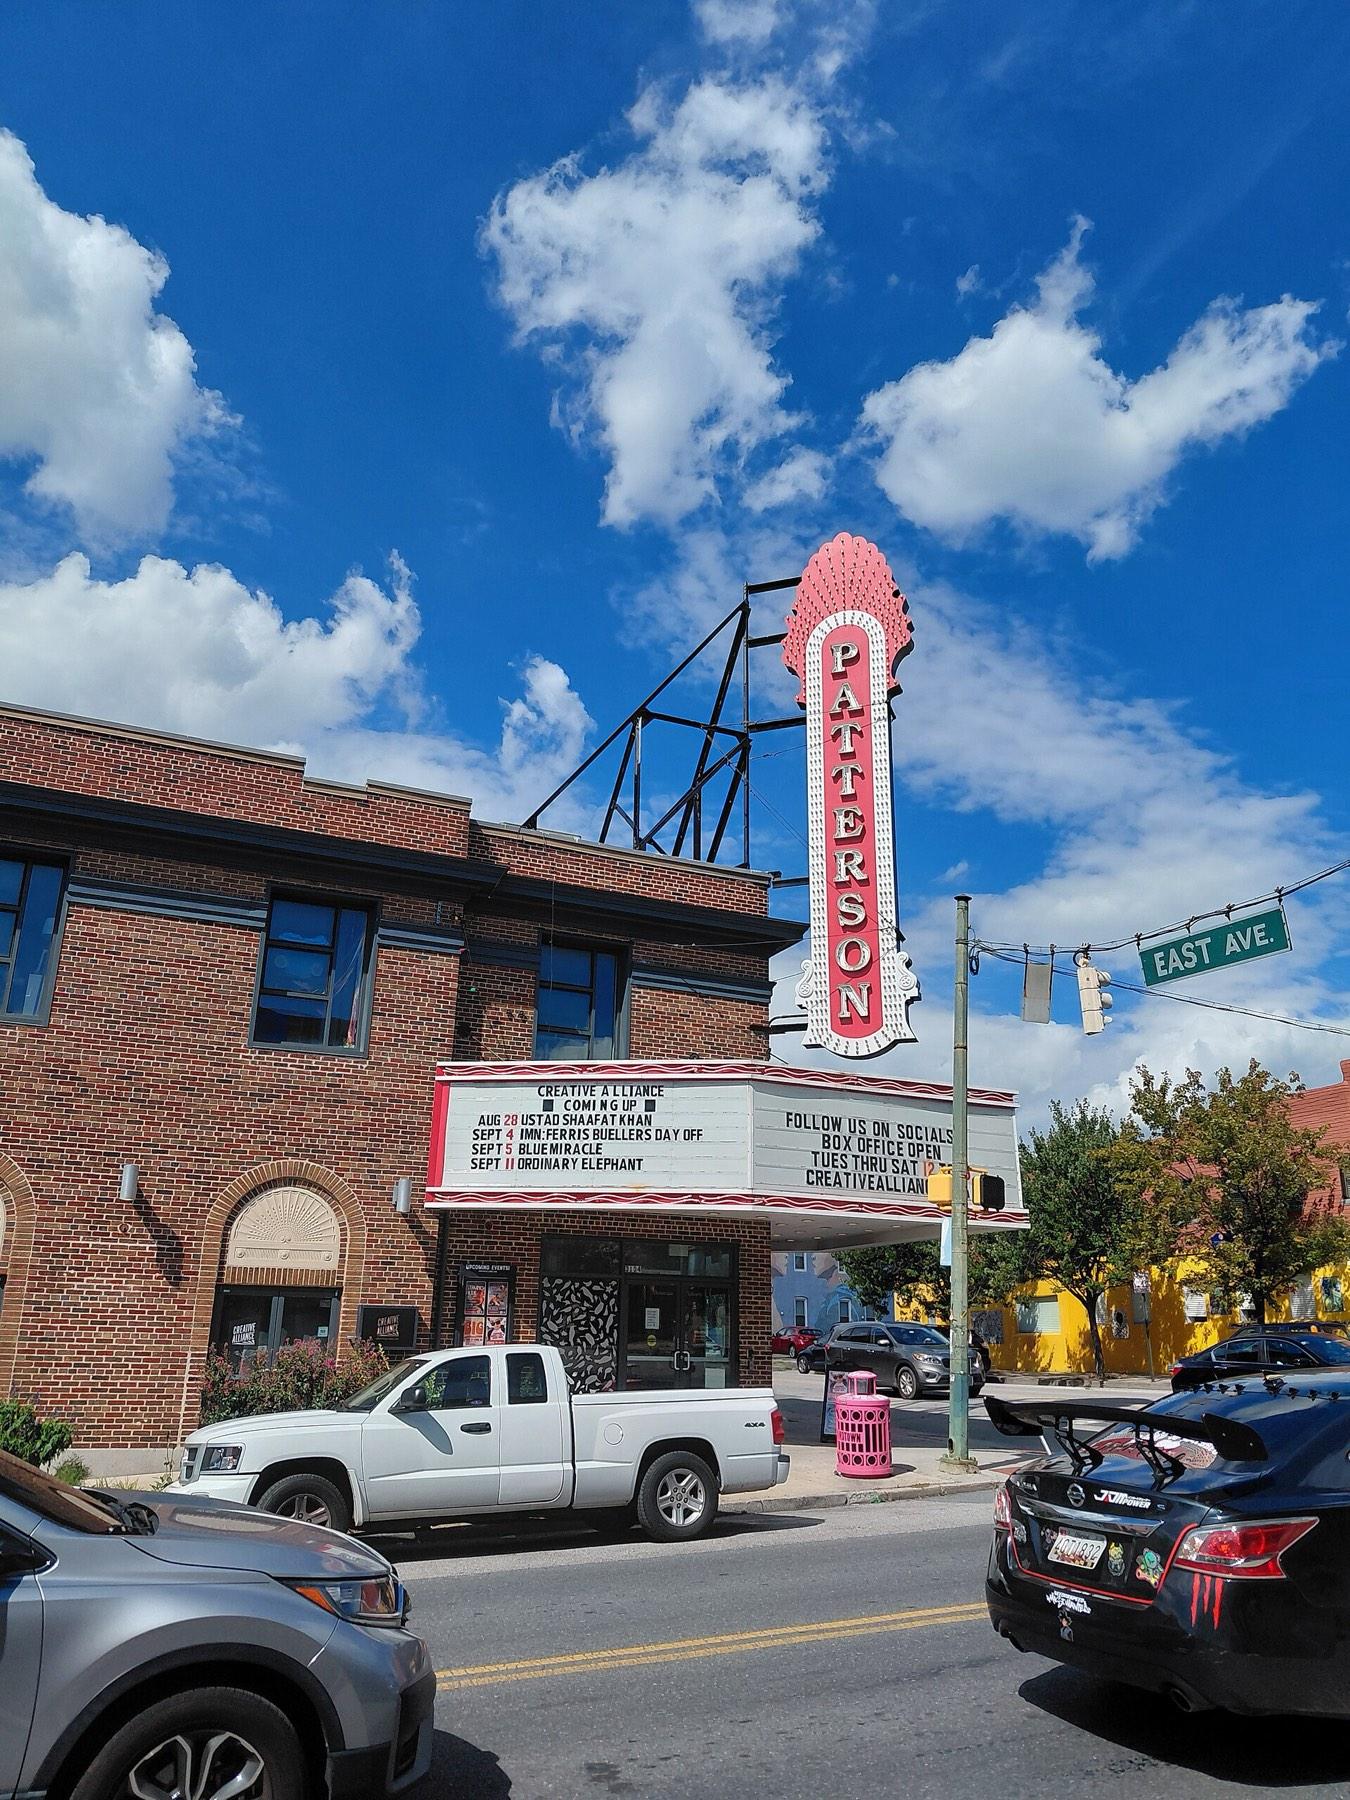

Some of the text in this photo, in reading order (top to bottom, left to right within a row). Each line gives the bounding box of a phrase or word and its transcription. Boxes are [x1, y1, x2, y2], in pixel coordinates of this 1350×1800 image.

[831, 642, 871, 1022] PATTERSON
[1153, 923, 1275, 977] EAST AVE.
[537, 1085, 664, 1097] CREATIVE ALLIANCE
[564, 1100, 637, 1111] COMING UP
[478, 1114, 652, 1126] AUG 28 USTAD SHAAFAT KHAN
[786, 1112, 953, 1144] FOLLOW US ON SOCIALS
[472, 1129, 501, 1141] SEPT
[505, 1129, 514, 1140] 4
[592, 1129, 652, 1141] BUELLERS
[655, 1129, 679, 1141] DAY
[683, 1129, 703, 1141] OFF
[471, 1143, 603, 1155] SEPT 5 BLUE MIRACLE
[822, 1134, 942, 1160] BOX OFFICE OPEN
[470, 1158, 500, 1170] SEPT
[517, 1158, 577, 1170] ORDINARY
[581, 1158, 643, 1170] ELEPHANT
[811, 1151, 848, 1169] TUES
[851, 1154, 887, 1173] THRU
[891, 1158, 918, 1176] SAT
[233, 1322, 256, 1334] CREATIVE
[232, 1332, 255, 1343] ALLIANCE
[1123, 1499, 1151, 1509] POWER
